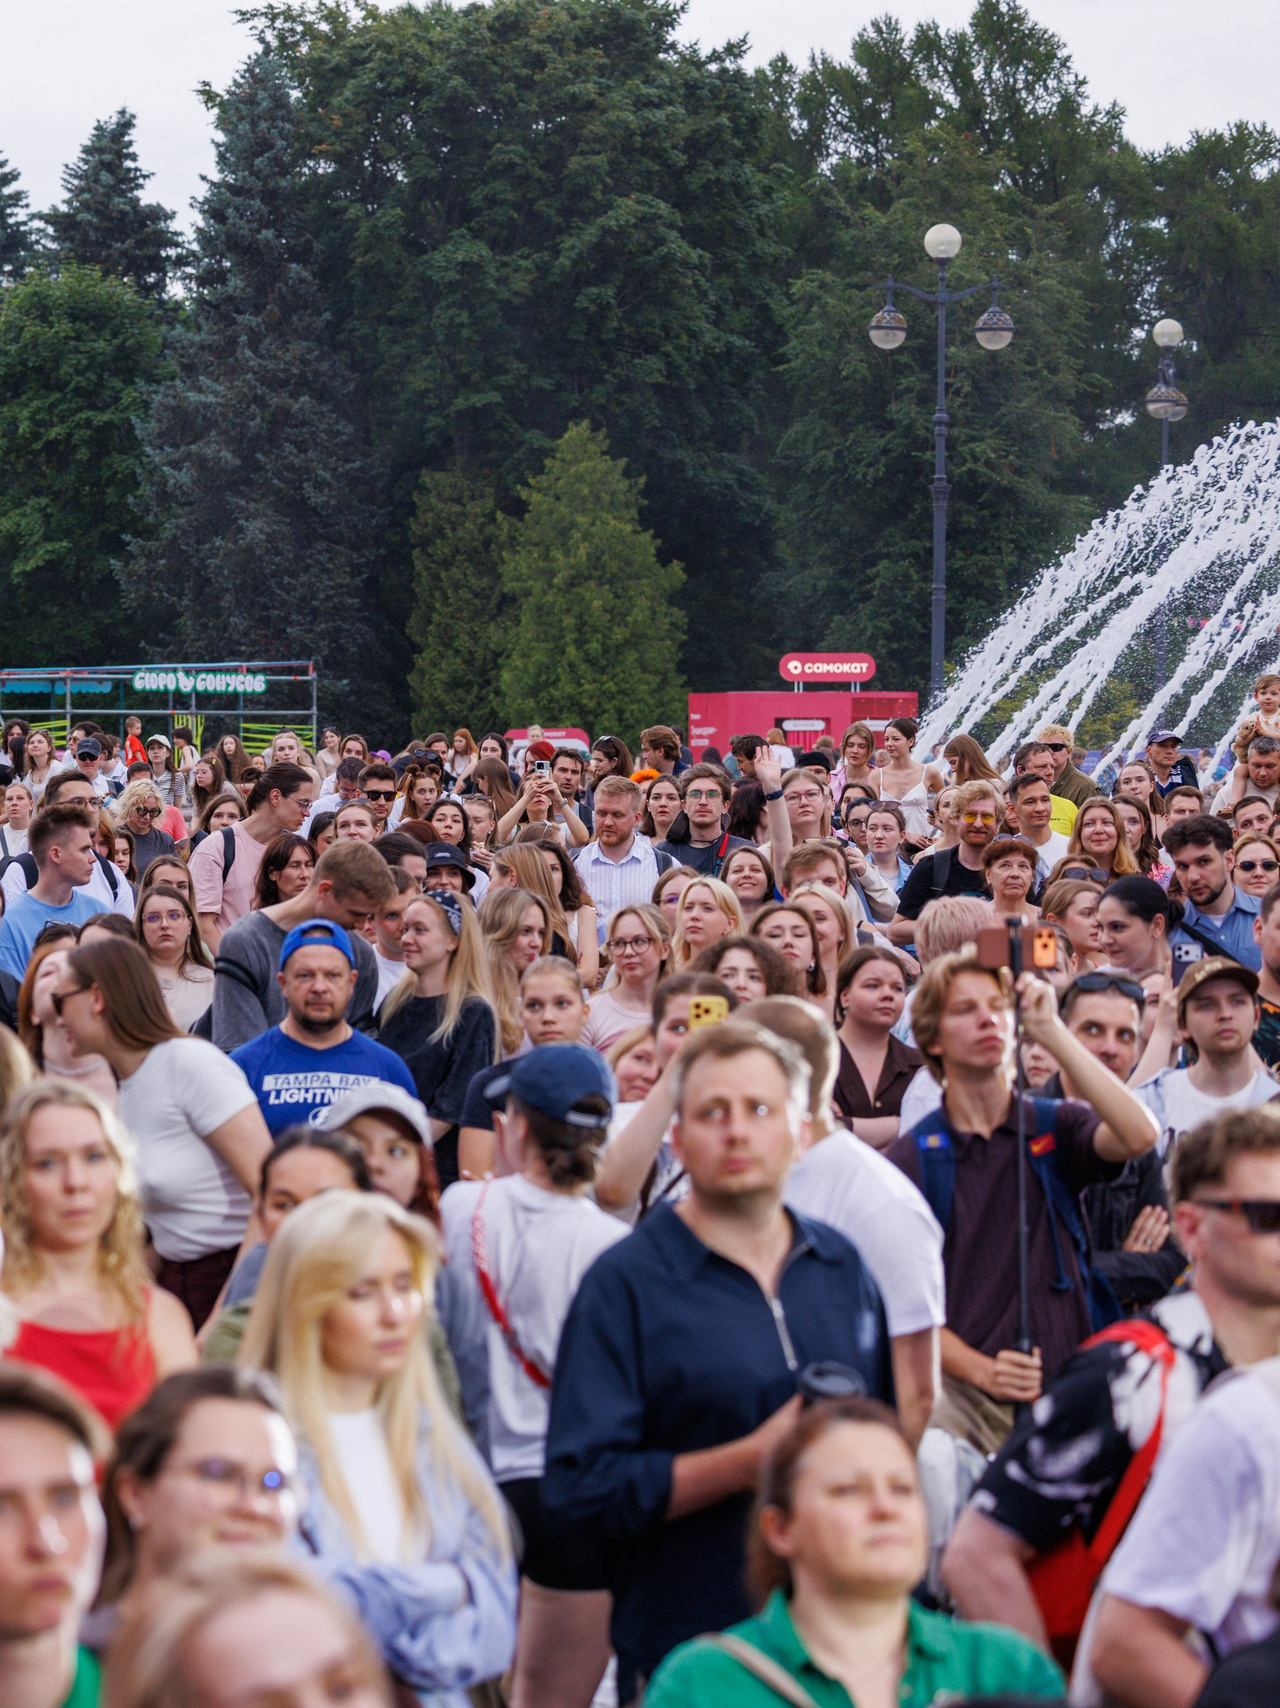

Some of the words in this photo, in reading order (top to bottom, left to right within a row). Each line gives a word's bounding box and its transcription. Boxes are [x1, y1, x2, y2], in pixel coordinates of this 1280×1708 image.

[133, 671, 177, 691] БЮРО
[272, 1074, 331, 1087] TAMPA
[339, 1075, 372, 1088] BAY
